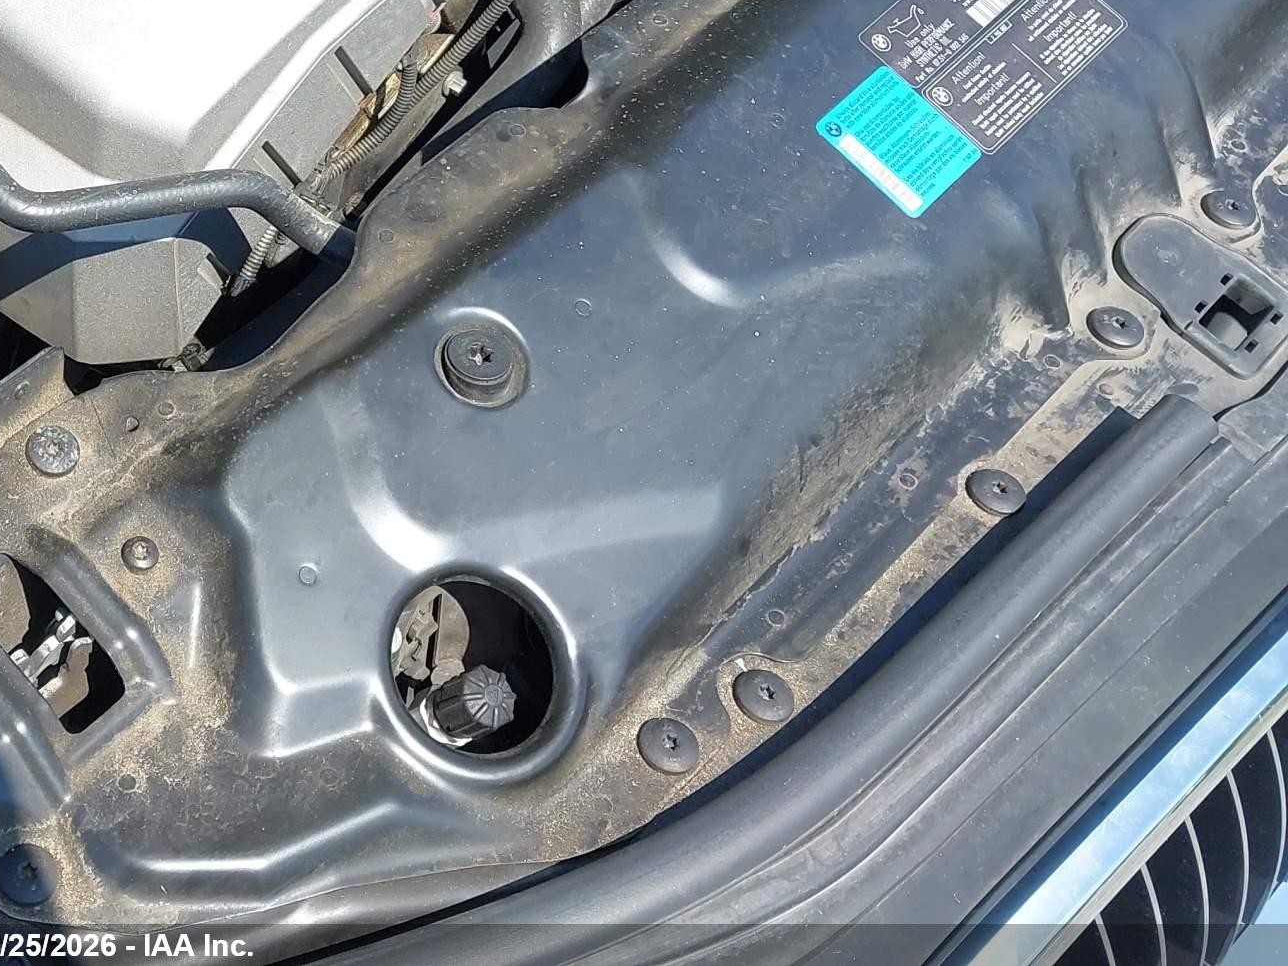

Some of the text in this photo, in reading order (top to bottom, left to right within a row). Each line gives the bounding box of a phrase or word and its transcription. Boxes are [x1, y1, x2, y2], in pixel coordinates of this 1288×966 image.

[903, 19, 939, 49] Use only
[1041, 9, 1079, 44] Important!
[907, 43, 926, 60] HIGH
[914, 41, 944, 68] SYNTHETIC
[948, 50, 987, 85] Attention!
[973, 71, 1012, 107] Important!
